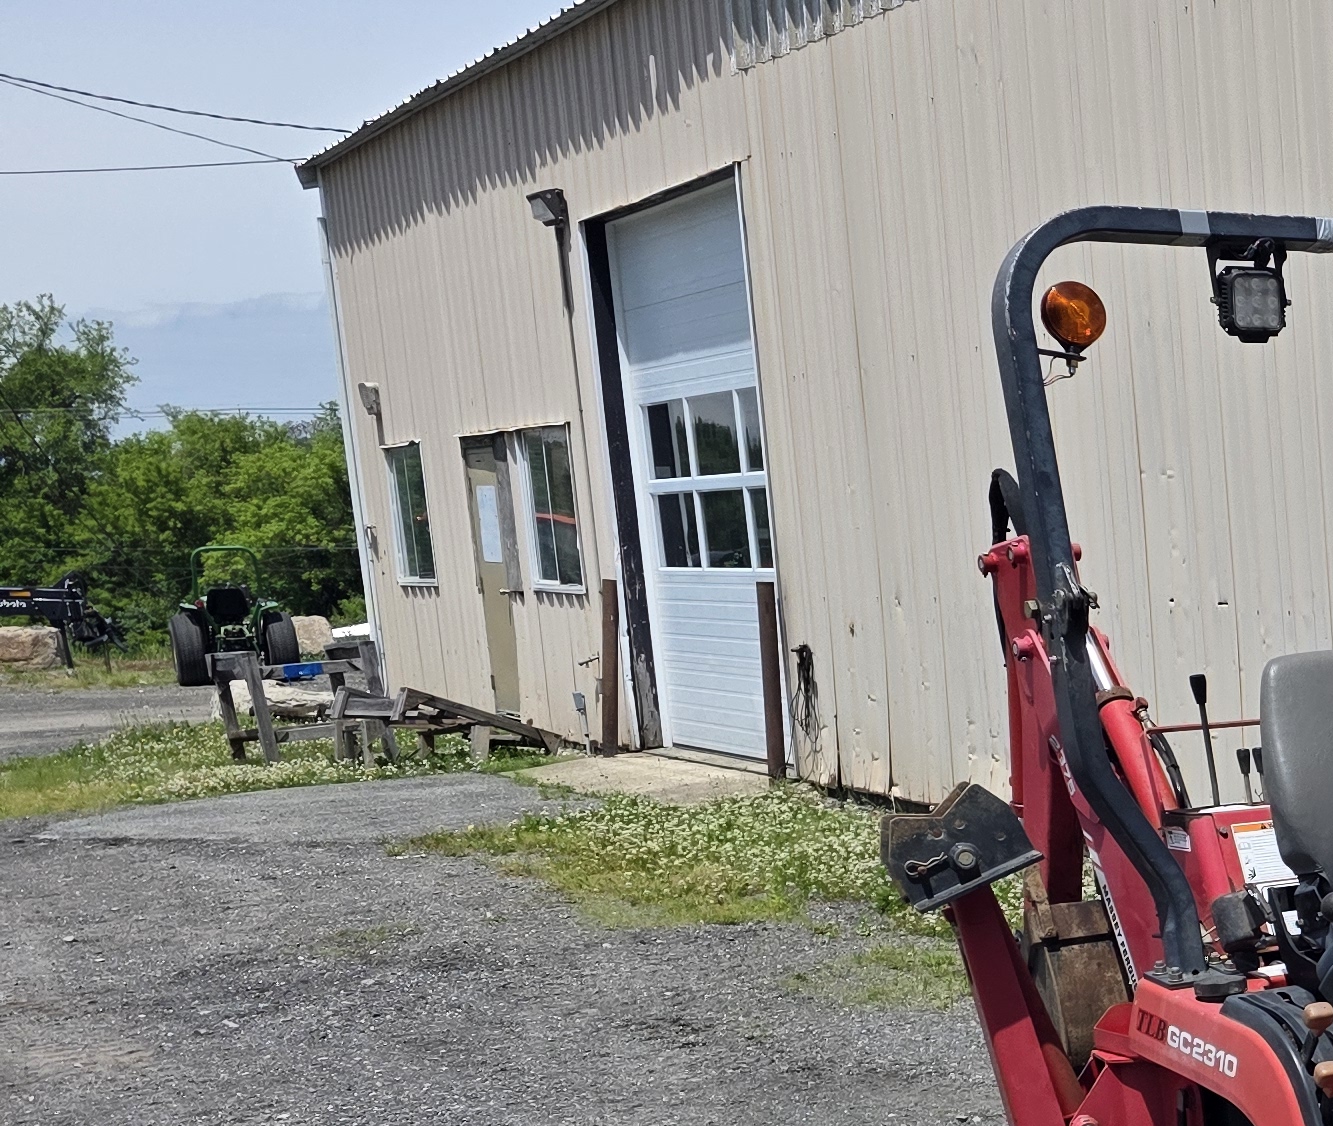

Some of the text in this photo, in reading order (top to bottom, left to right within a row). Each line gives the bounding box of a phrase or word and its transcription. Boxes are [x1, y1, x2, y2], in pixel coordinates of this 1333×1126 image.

[1101, 884, 1123, 939] MASSEY
[1137, 1009, 1238, 1078] TLB GC2310
